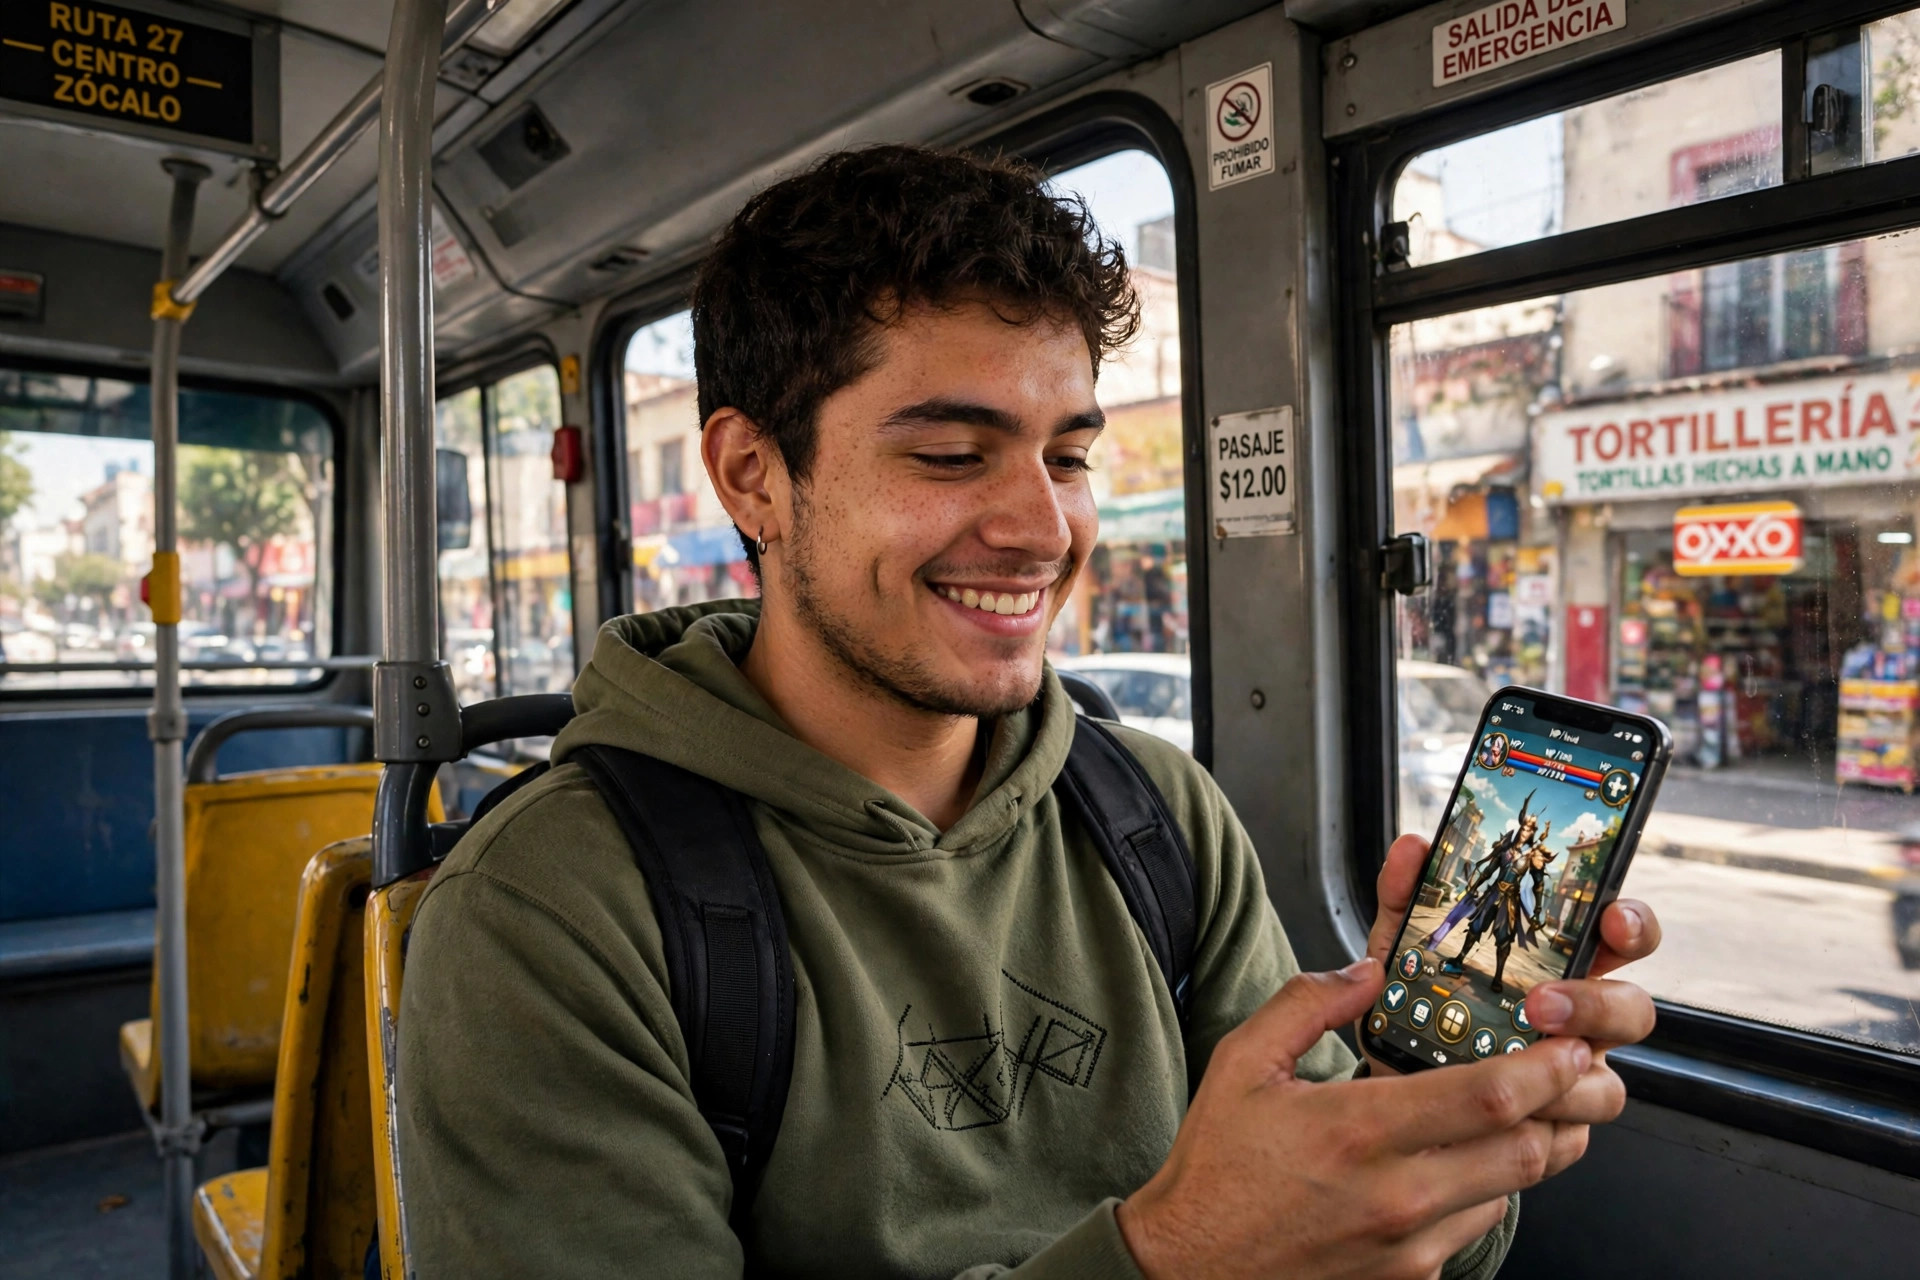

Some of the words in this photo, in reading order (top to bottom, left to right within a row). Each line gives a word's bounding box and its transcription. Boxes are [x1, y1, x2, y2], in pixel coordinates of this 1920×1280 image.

[50, 2, 138, 47] RUTA
[146, 24, 184, 54] 27
[1443, 2, 1614, 79] EMERGENCIA
[1448, 0, 1539, 48] SALIDA
[52, 39, 181, 89] CENTRO
[53, 73, 182, 122] ZÓCALO
[1213, 137, 1269, 166] PROHIBIDO
[1221, 156, 1262, 180] FUMAR
[1219, 429, 1285, 461] PASAJE
[1568, 384, 1898, 463] TORTILLERÍA
[1219, 465, 1287, 503] $12.00
[1576, 461, 1685, 493] TORTILLAS
[1693, 453, 1781, 484] HECHAS
[1791, 452, 1807, 476] A
[1815, 447, 1892, 474] MANO
[1675, 512, 1795, 567] OXXO
